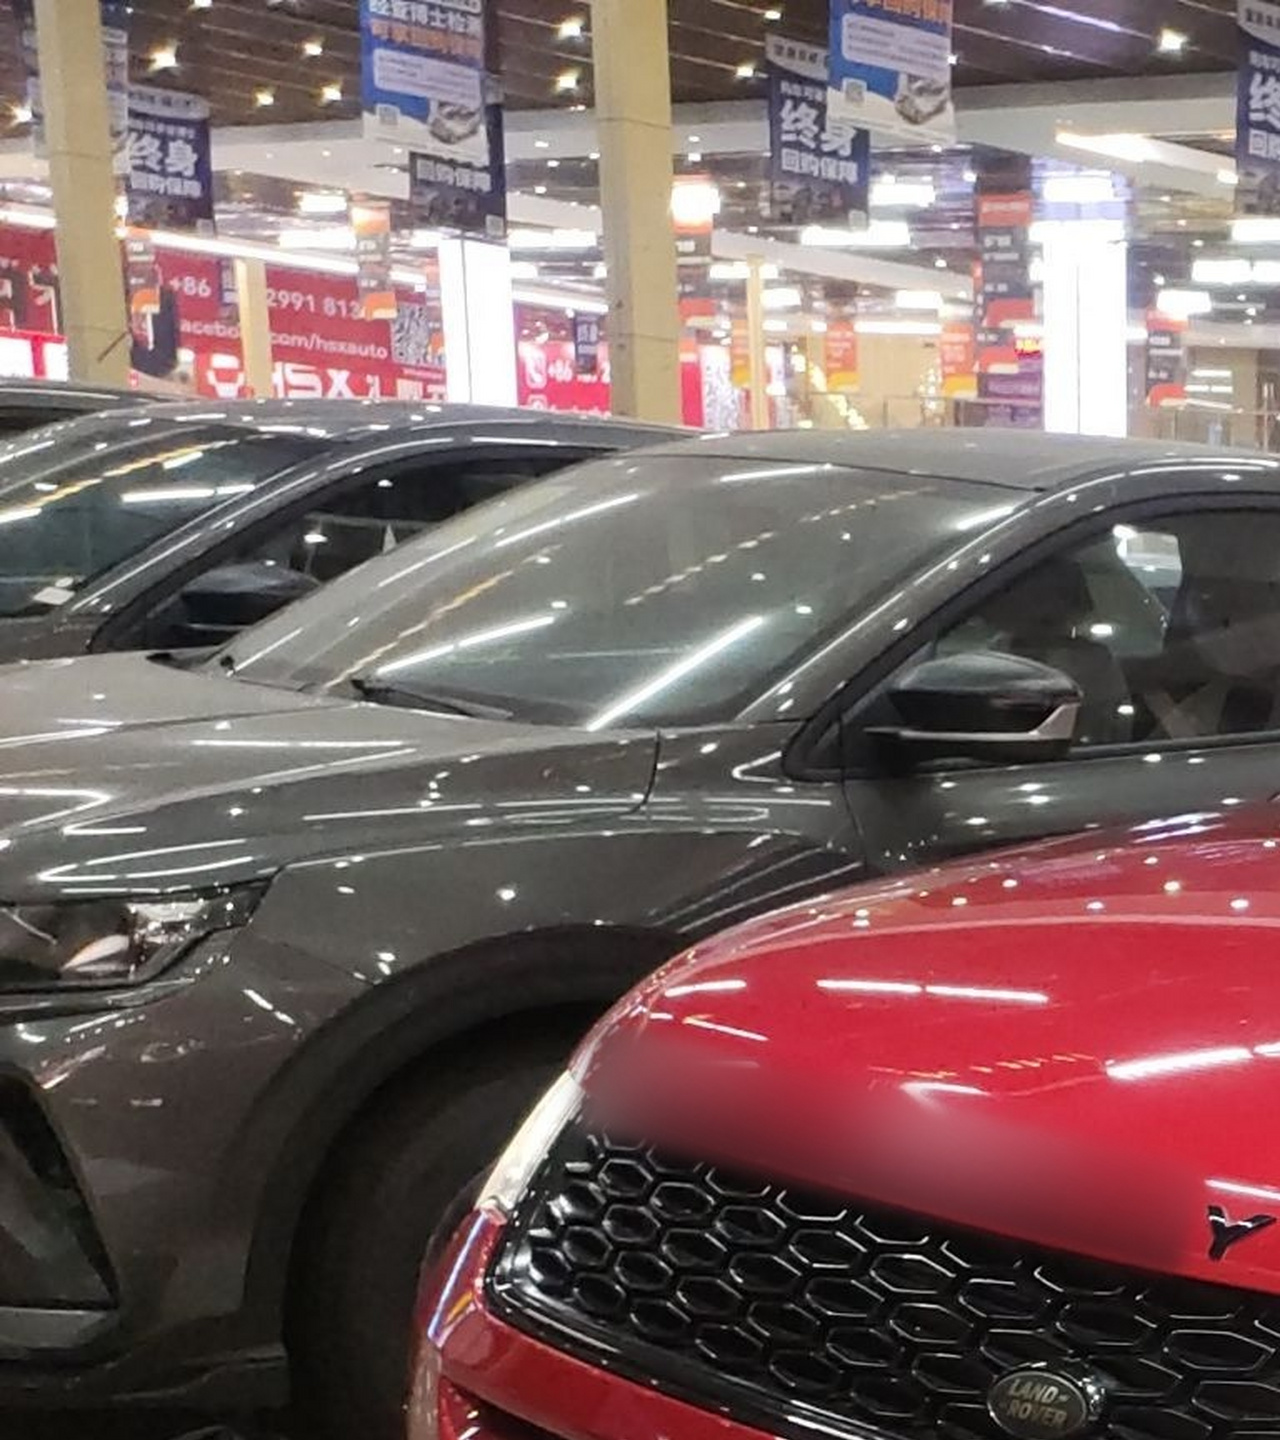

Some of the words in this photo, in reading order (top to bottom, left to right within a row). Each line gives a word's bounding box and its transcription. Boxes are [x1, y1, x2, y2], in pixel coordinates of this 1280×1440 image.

[780, 99, 856, 157] 终身
[128, 131, 198, 177] 终身
[781, 148, 858, 184] 回购保障
[169, 276, 212, 298] +86
[1007, 1400, 1068, 1426] ROVER
